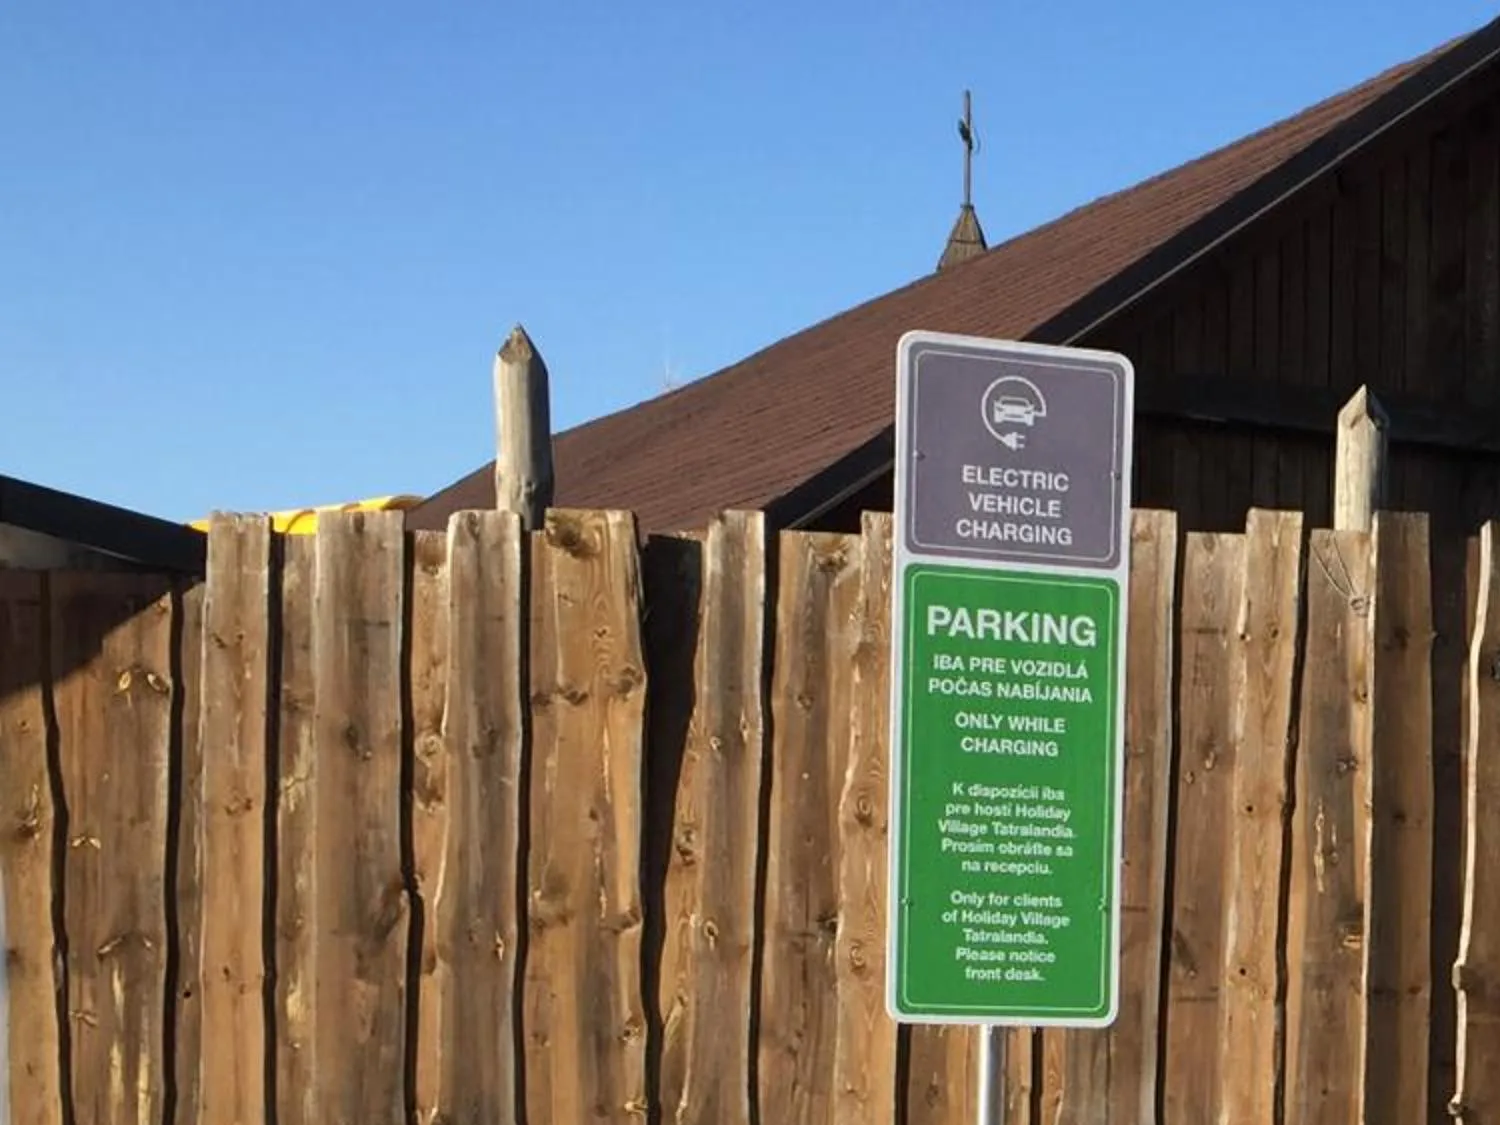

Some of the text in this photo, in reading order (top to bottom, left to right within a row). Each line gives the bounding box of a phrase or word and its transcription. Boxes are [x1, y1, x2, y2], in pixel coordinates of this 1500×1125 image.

[962, 465, 1069, 492] ELECTRIC
[969, 492, 1061, 517] VEHICLE
[956, 519, 1073, 546] CHARGING
[928, 605, 1096, 647] PARKING
[934, 653, 1088, 679] IBA PRE VOZIDLÁ
[928, 676, 1092, 703] POČAS NABÍJANIA
[955, 712, 1065, 733] ONLY WHILE
[960, 737, 1058, 757] CHARGING
[953, 782, 964, 795] K
[1042, 786, 1065, 800] iba
[946, 804, 970, 816] pre
[1016, 804, 1071, 822] Holiday
[938, 819, 988, 836] Village
[1056, 846, 1073, 856] sa
[962, 861, 1053, 876] na recepciu.
[951, 890, 1062, 908] Only for clients
[942, 911, 1070, 928] of Holiday Village
[962, 928, 1048, 944] Tatralandia.
[956, 947, 1056, 962] Please notice
[965, 966, 1045, 981] front desk.
